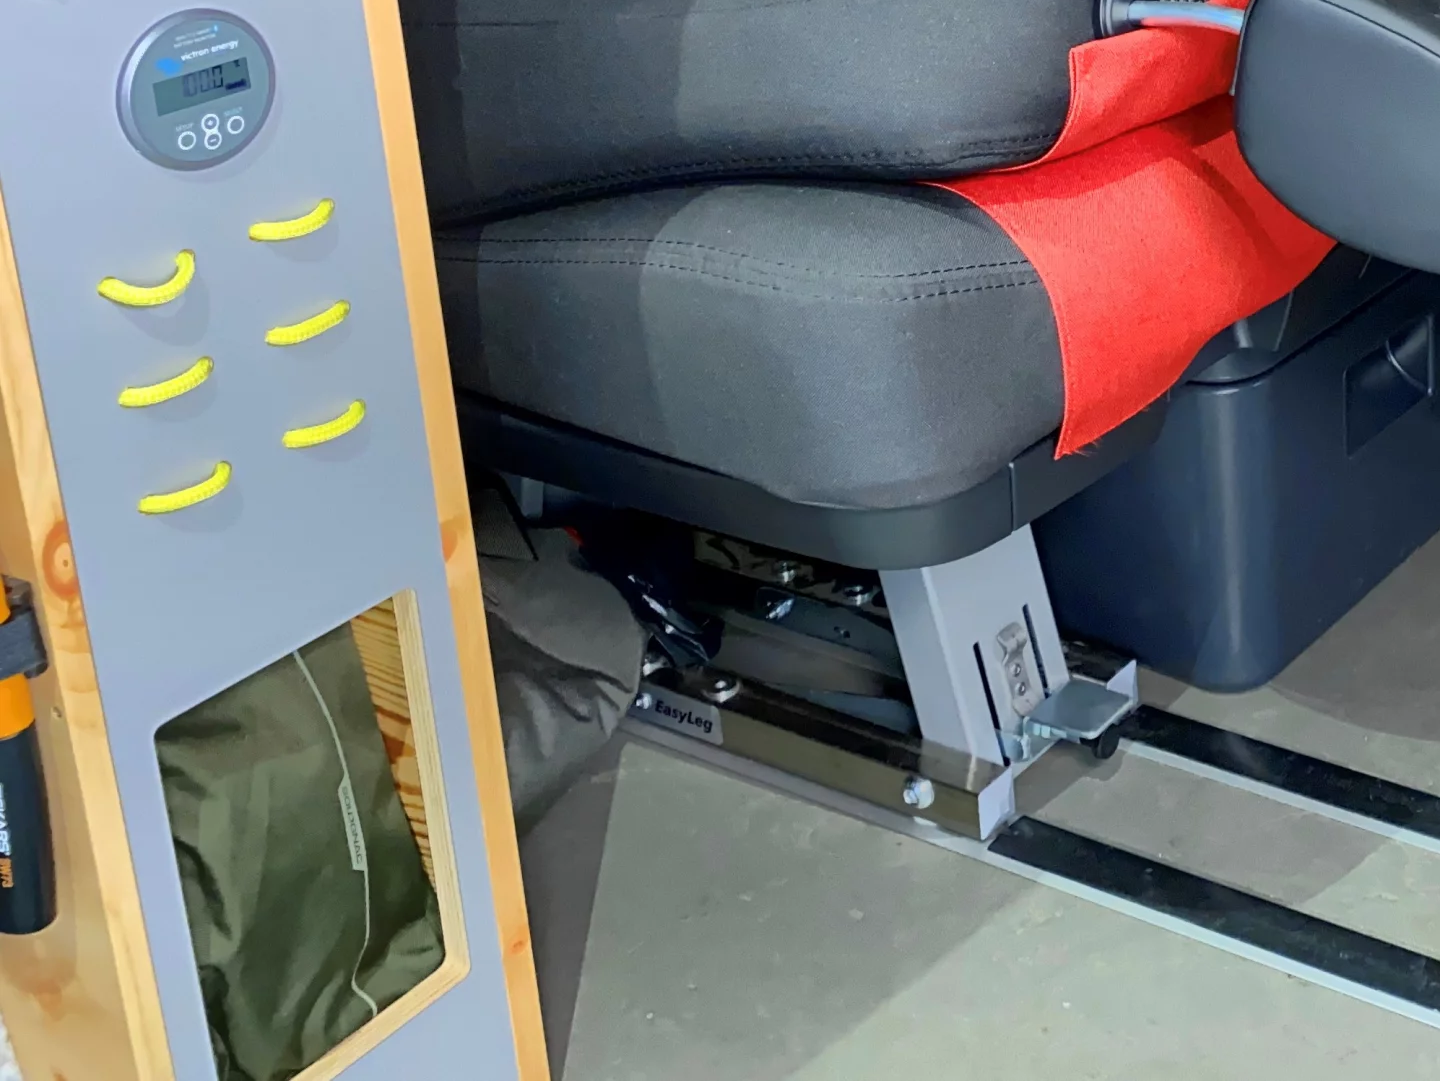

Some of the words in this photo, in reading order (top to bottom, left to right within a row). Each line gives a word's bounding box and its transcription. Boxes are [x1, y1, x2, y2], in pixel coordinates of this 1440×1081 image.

[180, 47, 210, 61] victron
[211, 39, 239, 54] energy
[655, 699, 713, 734] EasyLeg
